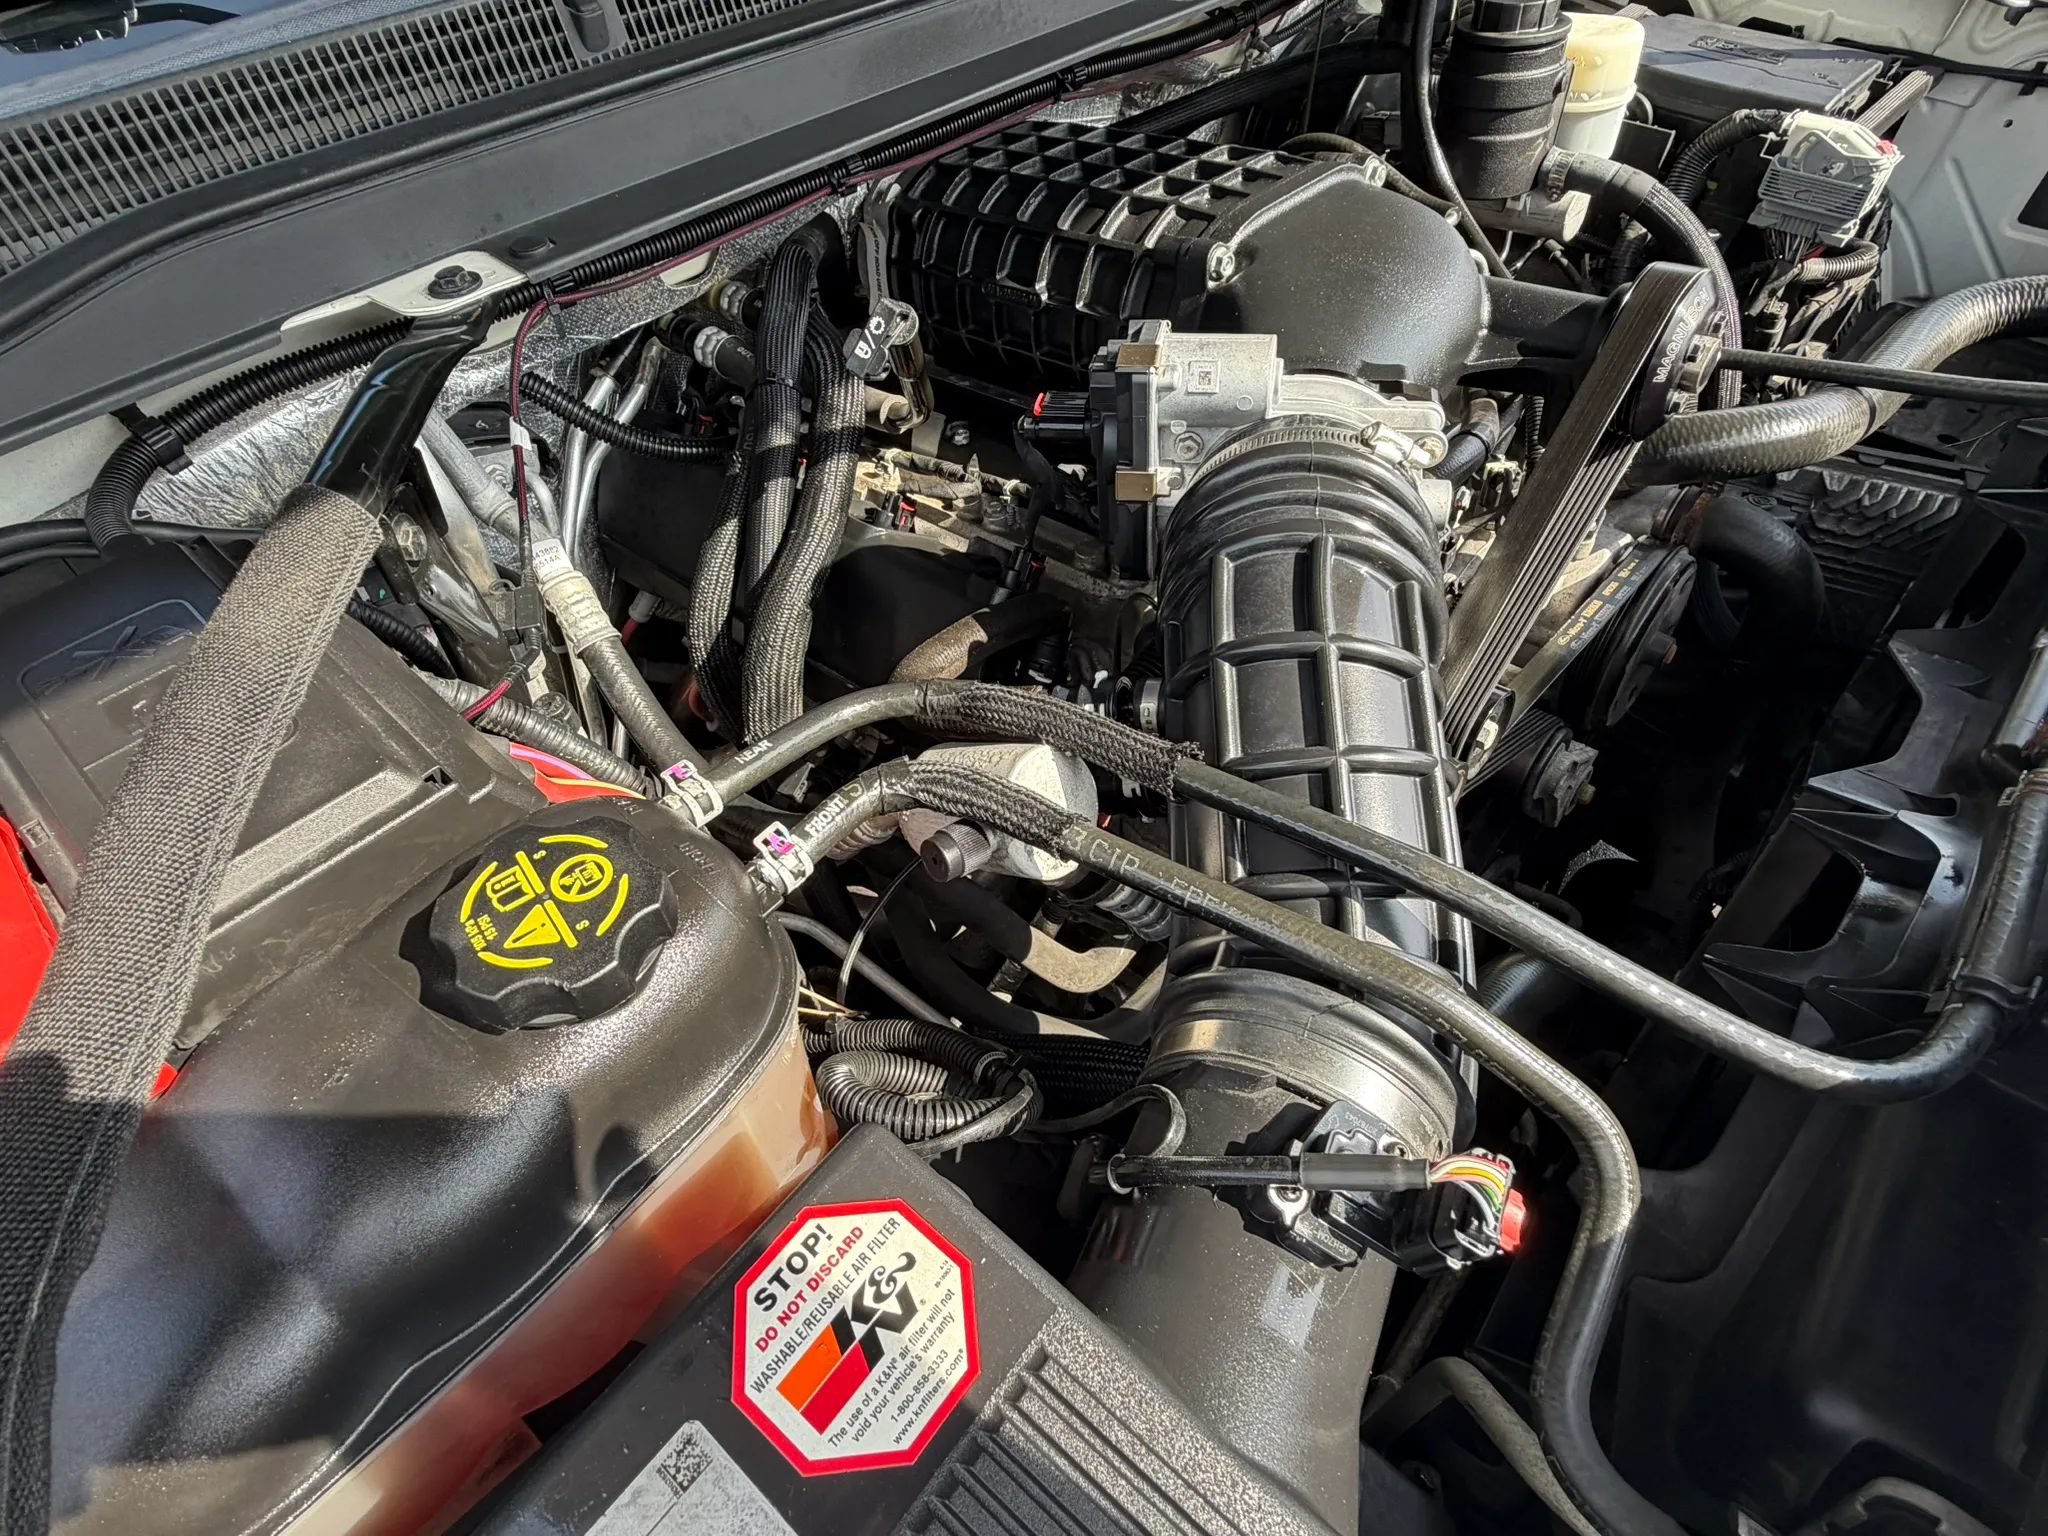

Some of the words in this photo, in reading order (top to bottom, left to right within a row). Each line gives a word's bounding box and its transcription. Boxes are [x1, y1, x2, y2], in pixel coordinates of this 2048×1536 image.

[1652, 287, 1709, 383] MAGNUSON
[804, 796, 845, 836] FRONT
[484, 926, 498, 941] 15
[750, 1271, 855, 1394] WASHABLE/REUSABLE
[851, 1252, 872, 1275] AIR
[867, 1217, 901, 1255] FILTER
[754, 1223, 833, 1312] STOP!
[755, 1326, 779, 1353] DO
[776, 1290, 808, 1327] NOT
[806, 1226, 864, 1292] DISCARD
[830, 1251, 918, 1373] K&N
[828, 1427, 848, 1448] The
[846, 1407, 864, 1427] use
[862, 1393, 873, 1408] of
[871, 1387, 879, 1396] a
[898, 1344, 911, 1362] air
[908, 1321, 929, 1347] filter
[926, 1304, 942, 1324] will
[940, 1288, 955, 1308] not
[852, 1417, 872, 1442] void
[870, 1394, 890, 1422] your
[920, 1311, 955, 1353] warranty
[890, 1349, 949, 1423] 1-800-858-3333
